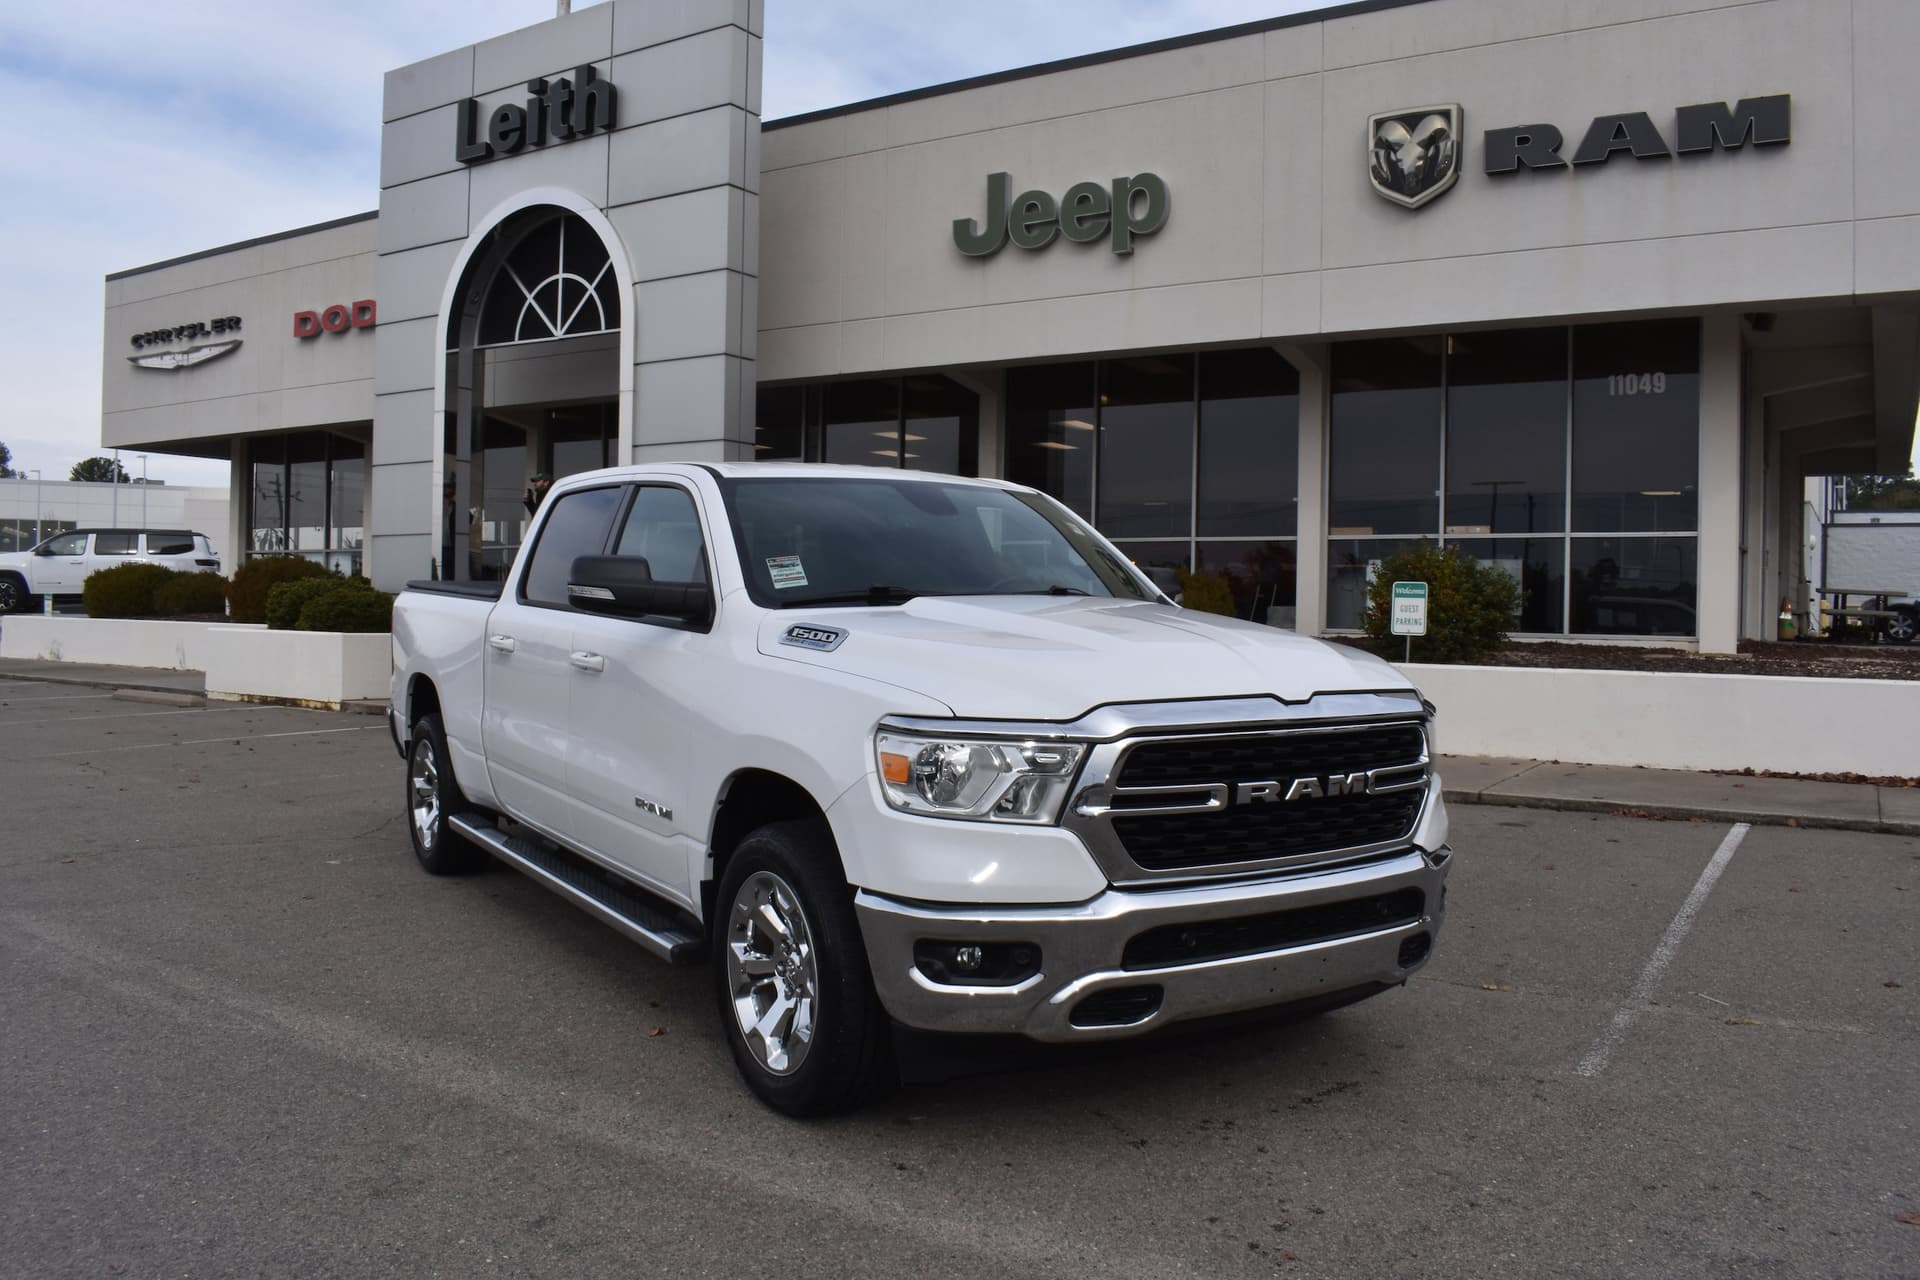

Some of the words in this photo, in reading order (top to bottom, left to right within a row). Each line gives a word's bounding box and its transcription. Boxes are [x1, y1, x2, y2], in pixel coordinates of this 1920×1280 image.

[456, 63, 617, 164] Leith
[1484, 94, 1792, 176] RAM
[953, 171, 1171, 255] Jeep
[131, 316, 242, 348] CHRYSLER
[1608, 372, 1666, 396] 11049
[1396, 617, 1423, 626] PARKING
[1400, 604, 1419, 613] GUEST
[791, 627, 837, 642] 1500
[1236, 772, 1367, 805] RAM
